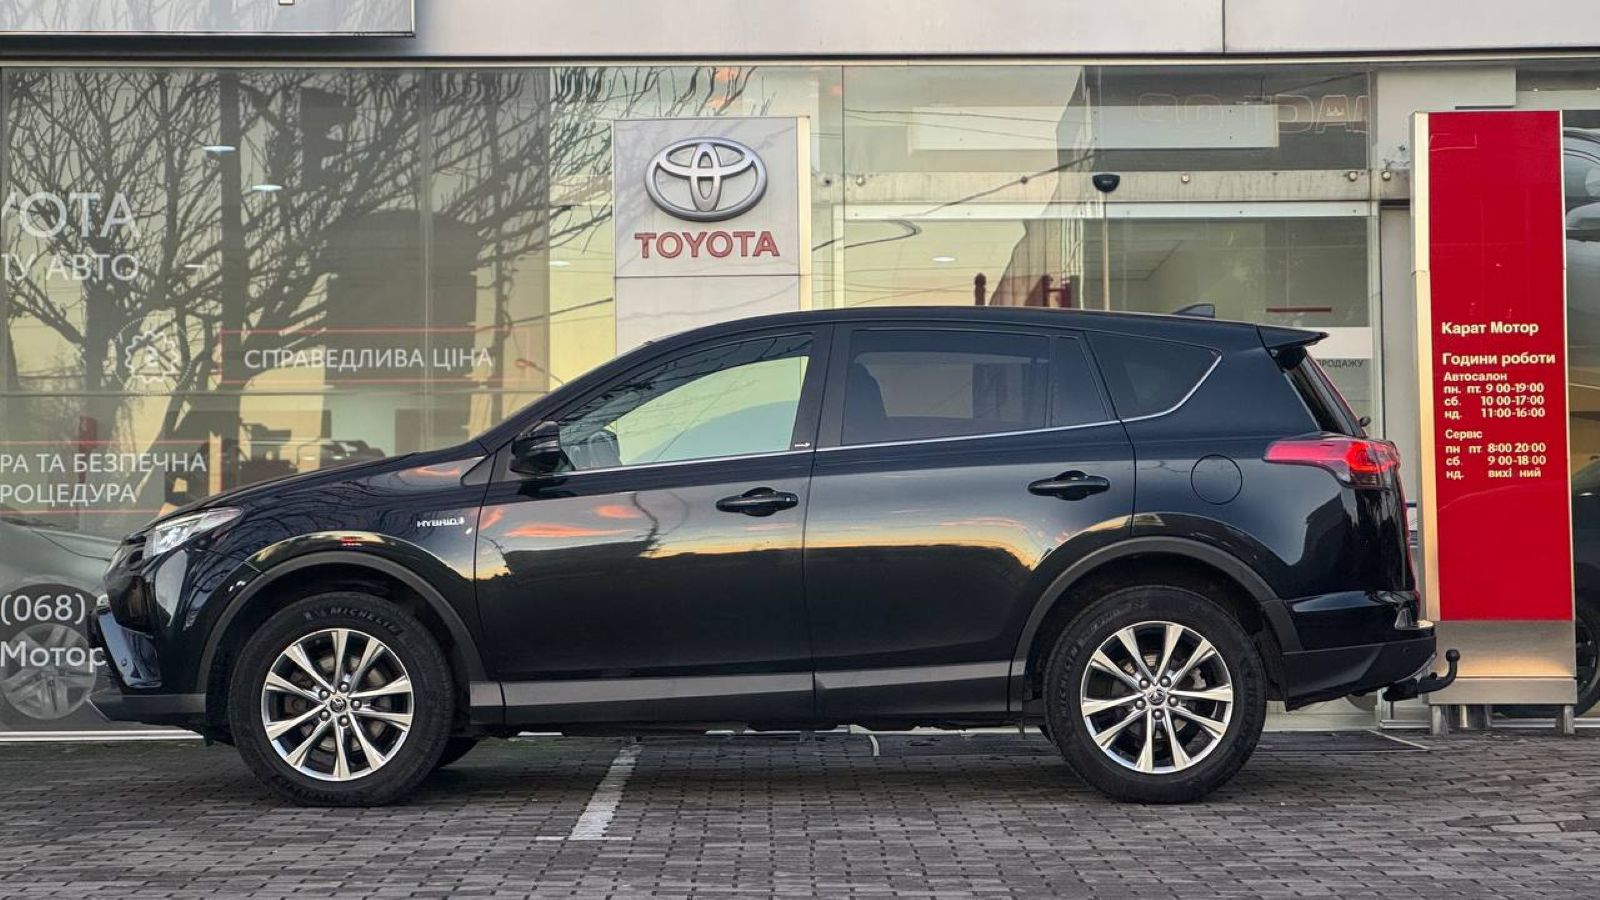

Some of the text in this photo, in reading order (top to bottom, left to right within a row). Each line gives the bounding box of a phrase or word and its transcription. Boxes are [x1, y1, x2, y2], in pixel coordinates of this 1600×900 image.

[634, 231, 780, 259] TOYOTA
[46, 253, 139, 281] АВТО
[1441, 321, 1539, 337] Карат Мотор
[244, 347, 493, 372] СПРАВЕДЛИВА ЦІНА
[1442, 351, 1556, 367] Години роботи
[1443, 371, 1508, 382] Автосалон
[1445, 429, 1483, 441] Сервіс
[0, 452, 207, 473] РА ТА БЕЗПЕЧНА
[0, 483, 137, 507] РОЦЕДУРА
[1, 593, 86, 625] (068)
